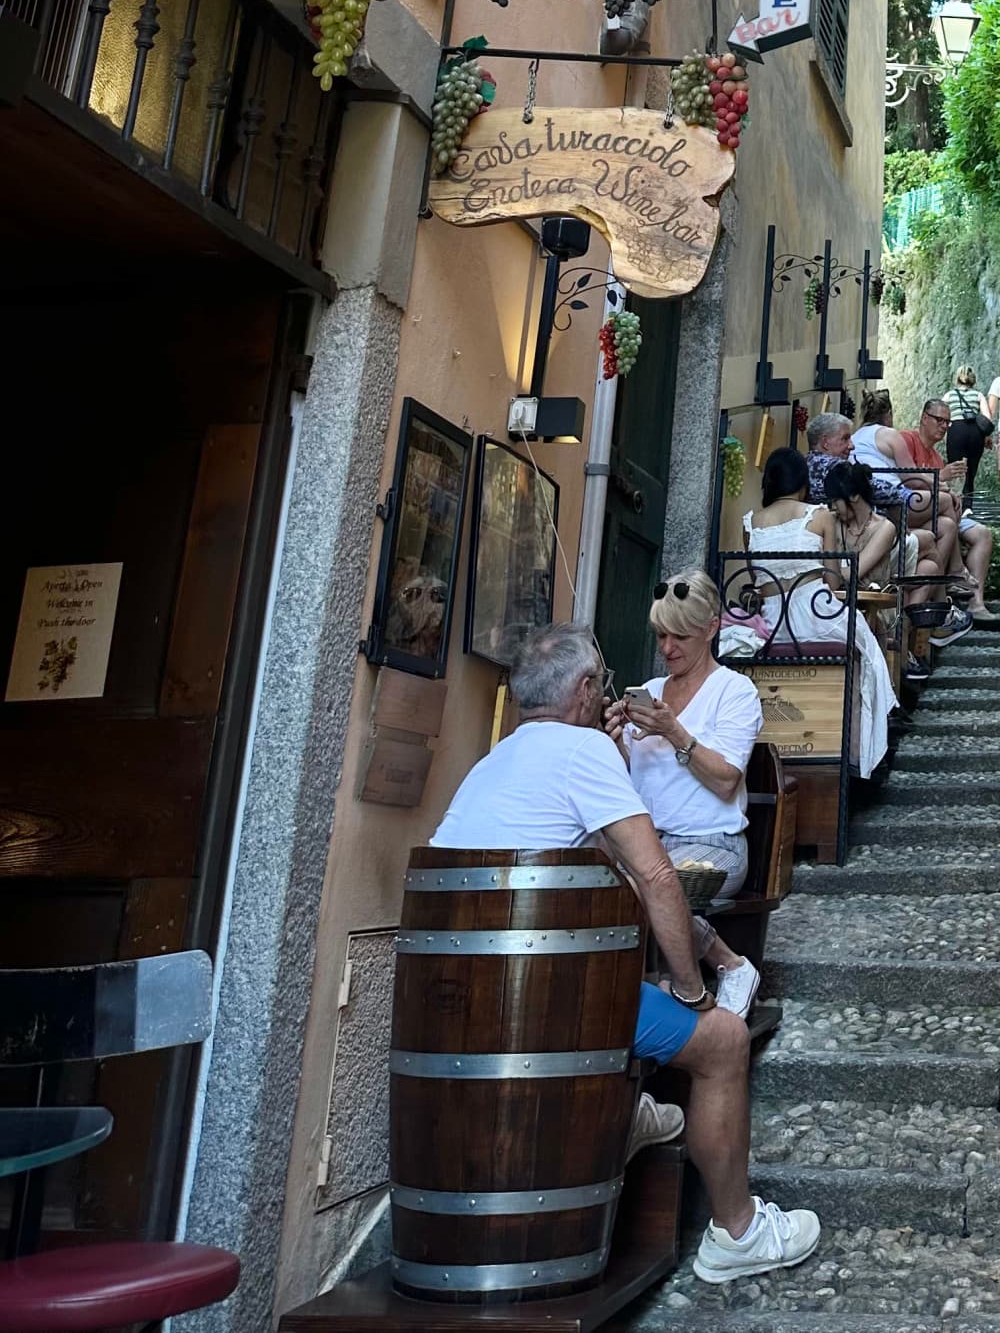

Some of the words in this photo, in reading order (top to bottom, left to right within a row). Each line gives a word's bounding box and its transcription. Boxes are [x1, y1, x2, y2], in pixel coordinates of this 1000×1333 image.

[735, 9, 800, 44] Bar
[463, 167, 577, 213] Enoteca
[591, 158, 661, 220] Wine
